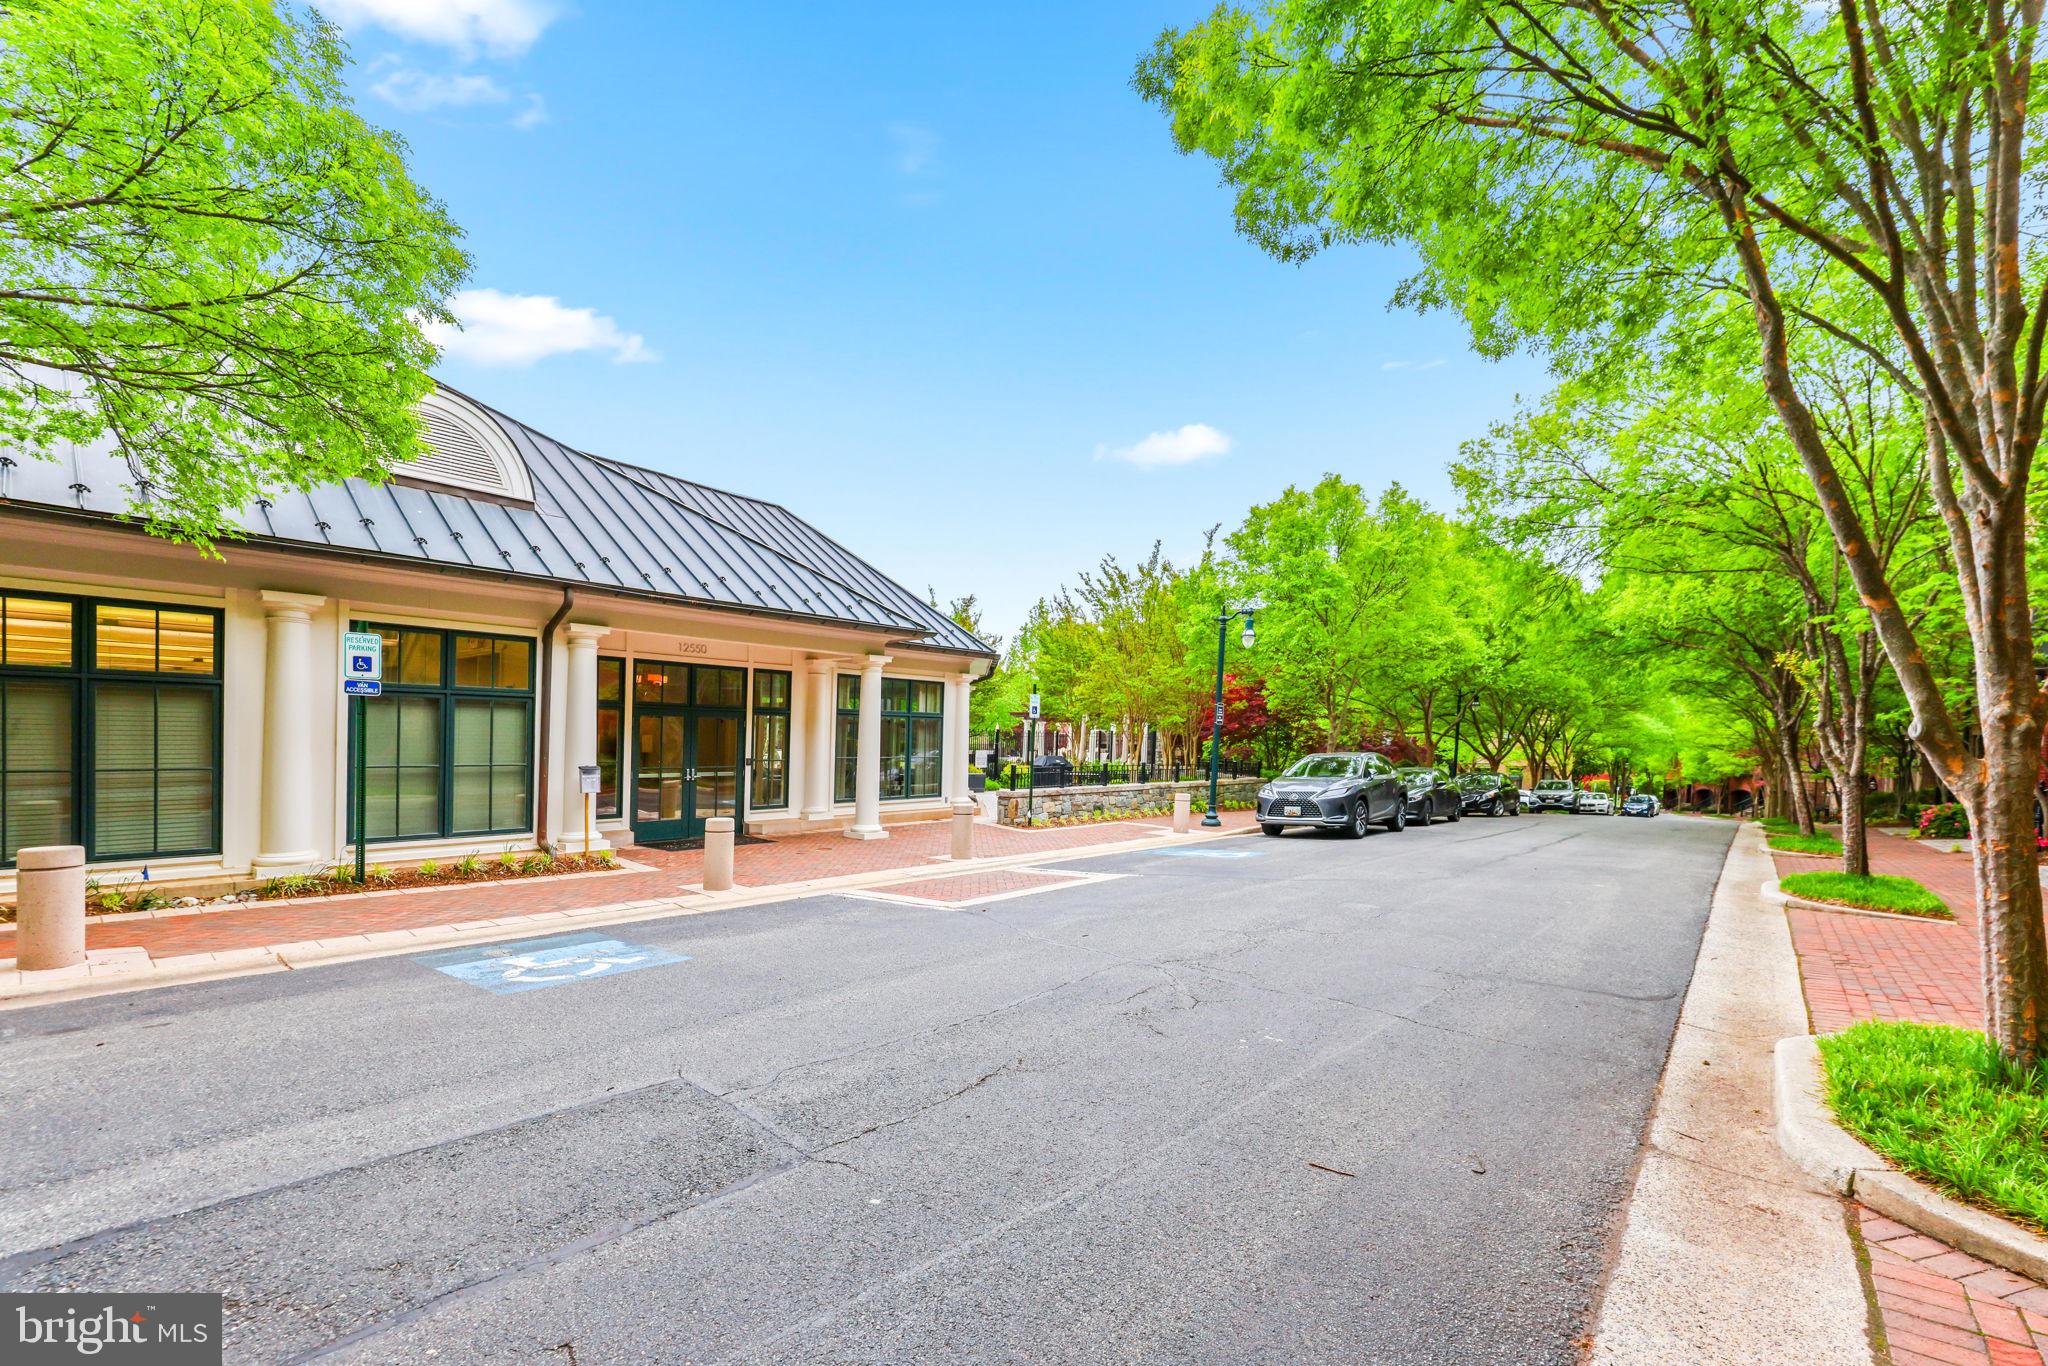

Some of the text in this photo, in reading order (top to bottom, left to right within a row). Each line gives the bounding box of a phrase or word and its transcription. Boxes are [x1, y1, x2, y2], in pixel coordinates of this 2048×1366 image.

[346, 636, 378, 645] RESERVED
[348, 645, 377, 653] PARKING
[678, 642, 708, 654] 12550
